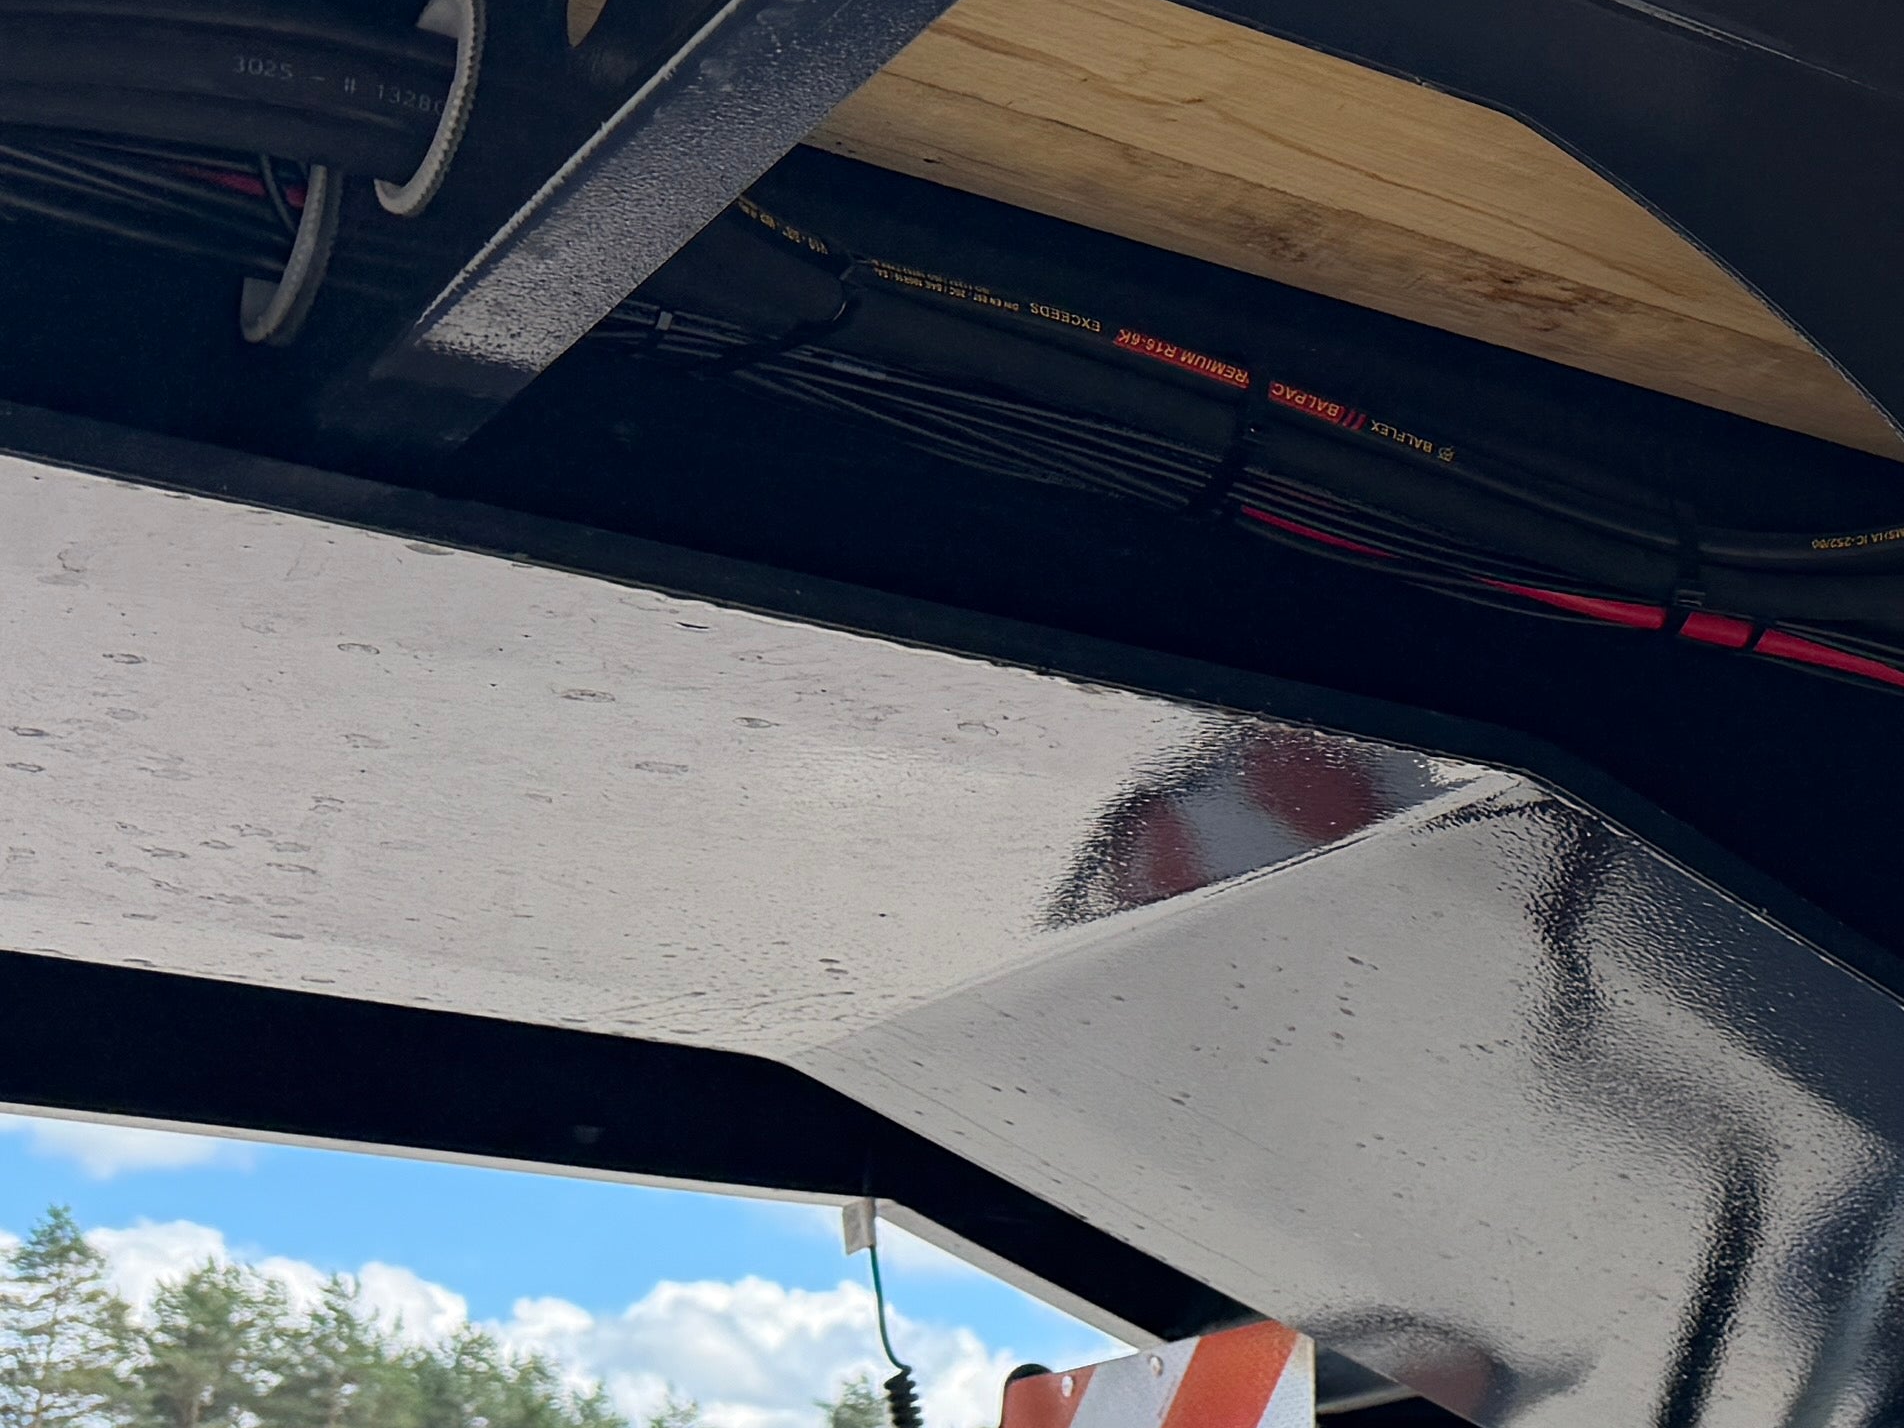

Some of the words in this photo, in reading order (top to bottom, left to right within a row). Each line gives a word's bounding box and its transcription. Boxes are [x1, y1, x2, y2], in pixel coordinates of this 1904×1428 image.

[1029, 301, 1102, 333] EXCEEDS
[1180, 350, 1249, 384] REMIUM
[1271, 382, 1341, 418] BALPAC
[1369, 419, 1434, 454] BALFLEX
